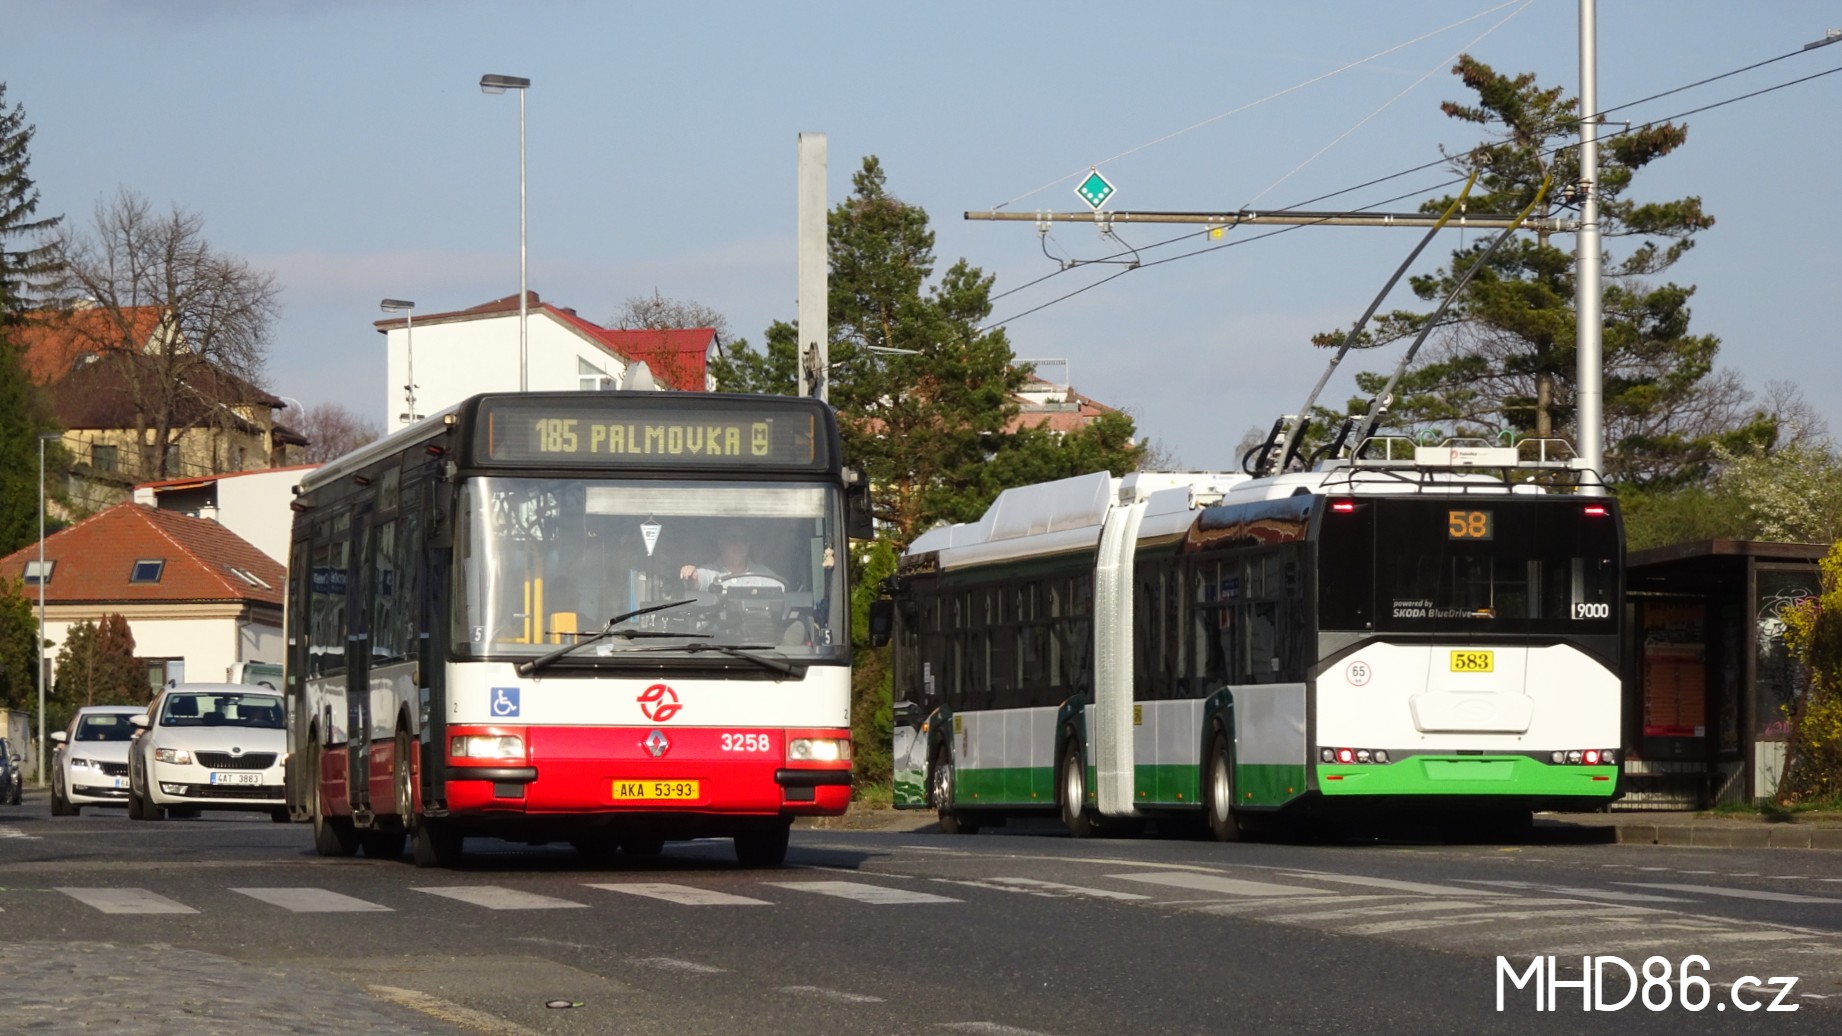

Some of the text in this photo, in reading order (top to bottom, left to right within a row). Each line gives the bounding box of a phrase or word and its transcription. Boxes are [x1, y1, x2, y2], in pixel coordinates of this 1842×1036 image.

[536, 419, 578, 452] 185
[591, 424, 740, 455] PALMOVKA
[1449, 511, 1486, 537] 58
[1393, 600, 1433, 608] powered by
[1577, 603, 1609, 618] 9000
[1393, 608, 1472, 618] SKODA BlueDrive
[474, 627, 482, 641] 5
[825, 630, 831, 644] 5
[1455, 653, 1489, 670] 583
[1352, 665, 1366, 677] 65
[453, 702, 458, 713] 2
[721, 733, 770, 752] 3258
[218, 774, 258, 783] 4AT 3883
[620, 783, 692, 797] AKA 53-93
